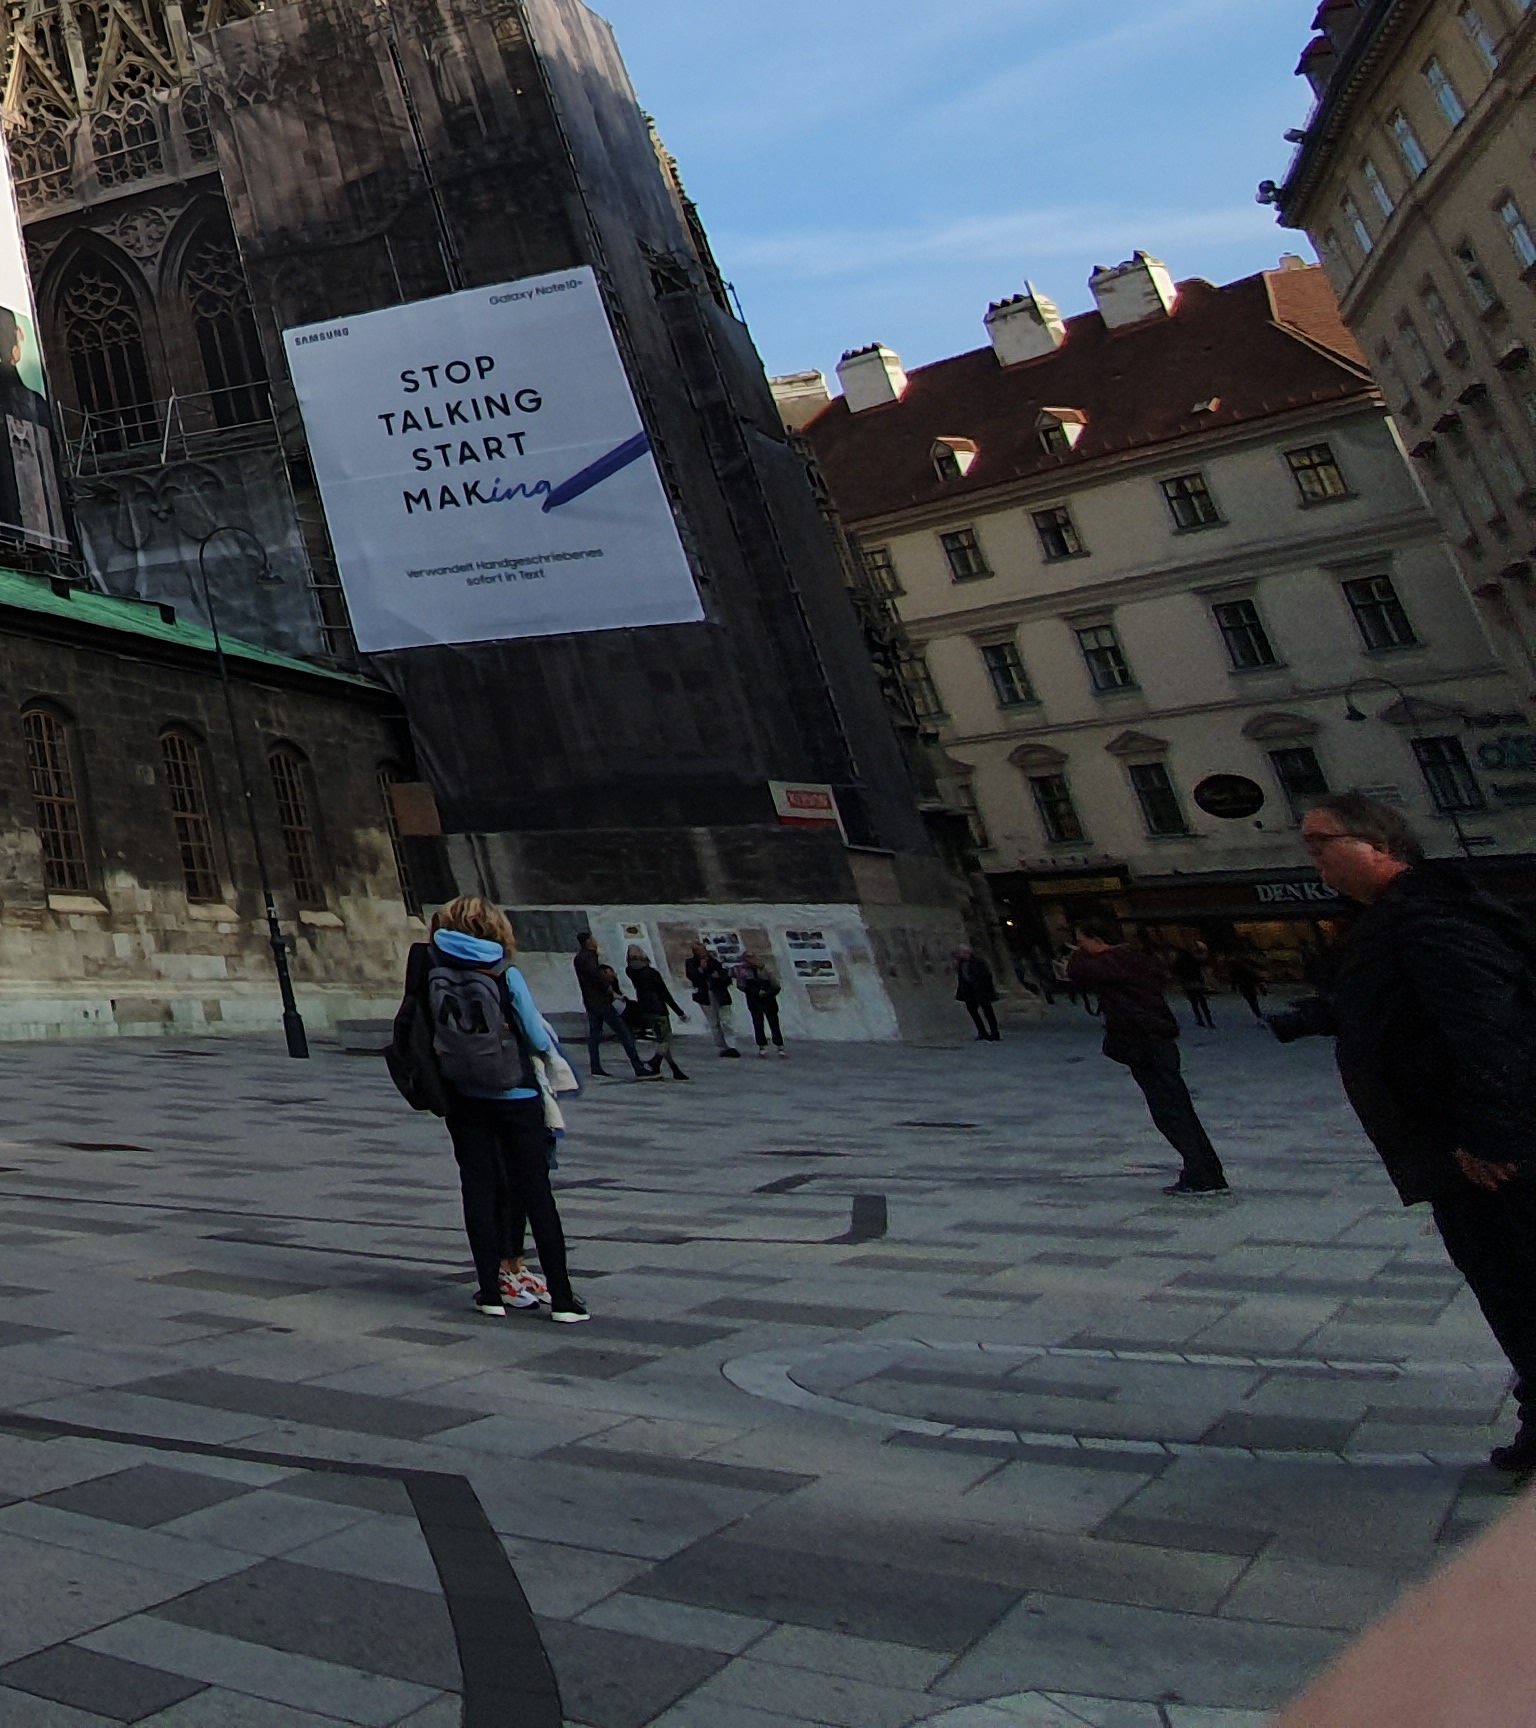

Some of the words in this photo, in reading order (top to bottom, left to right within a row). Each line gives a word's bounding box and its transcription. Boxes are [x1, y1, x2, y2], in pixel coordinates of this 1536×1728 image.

[489, 289, 533, 306] Galaxy
[294, 327, 350, 346] SAMSUNG
[400, 355, 496, 393] STOP
[378, 388, 543, 436] TALKING
[411, 431, 527, 472] START
[476, 548, 604, 571] Handgeschriebenes
[466, 572, 503, 587] sofort
[504, 571, 518, 583] in
